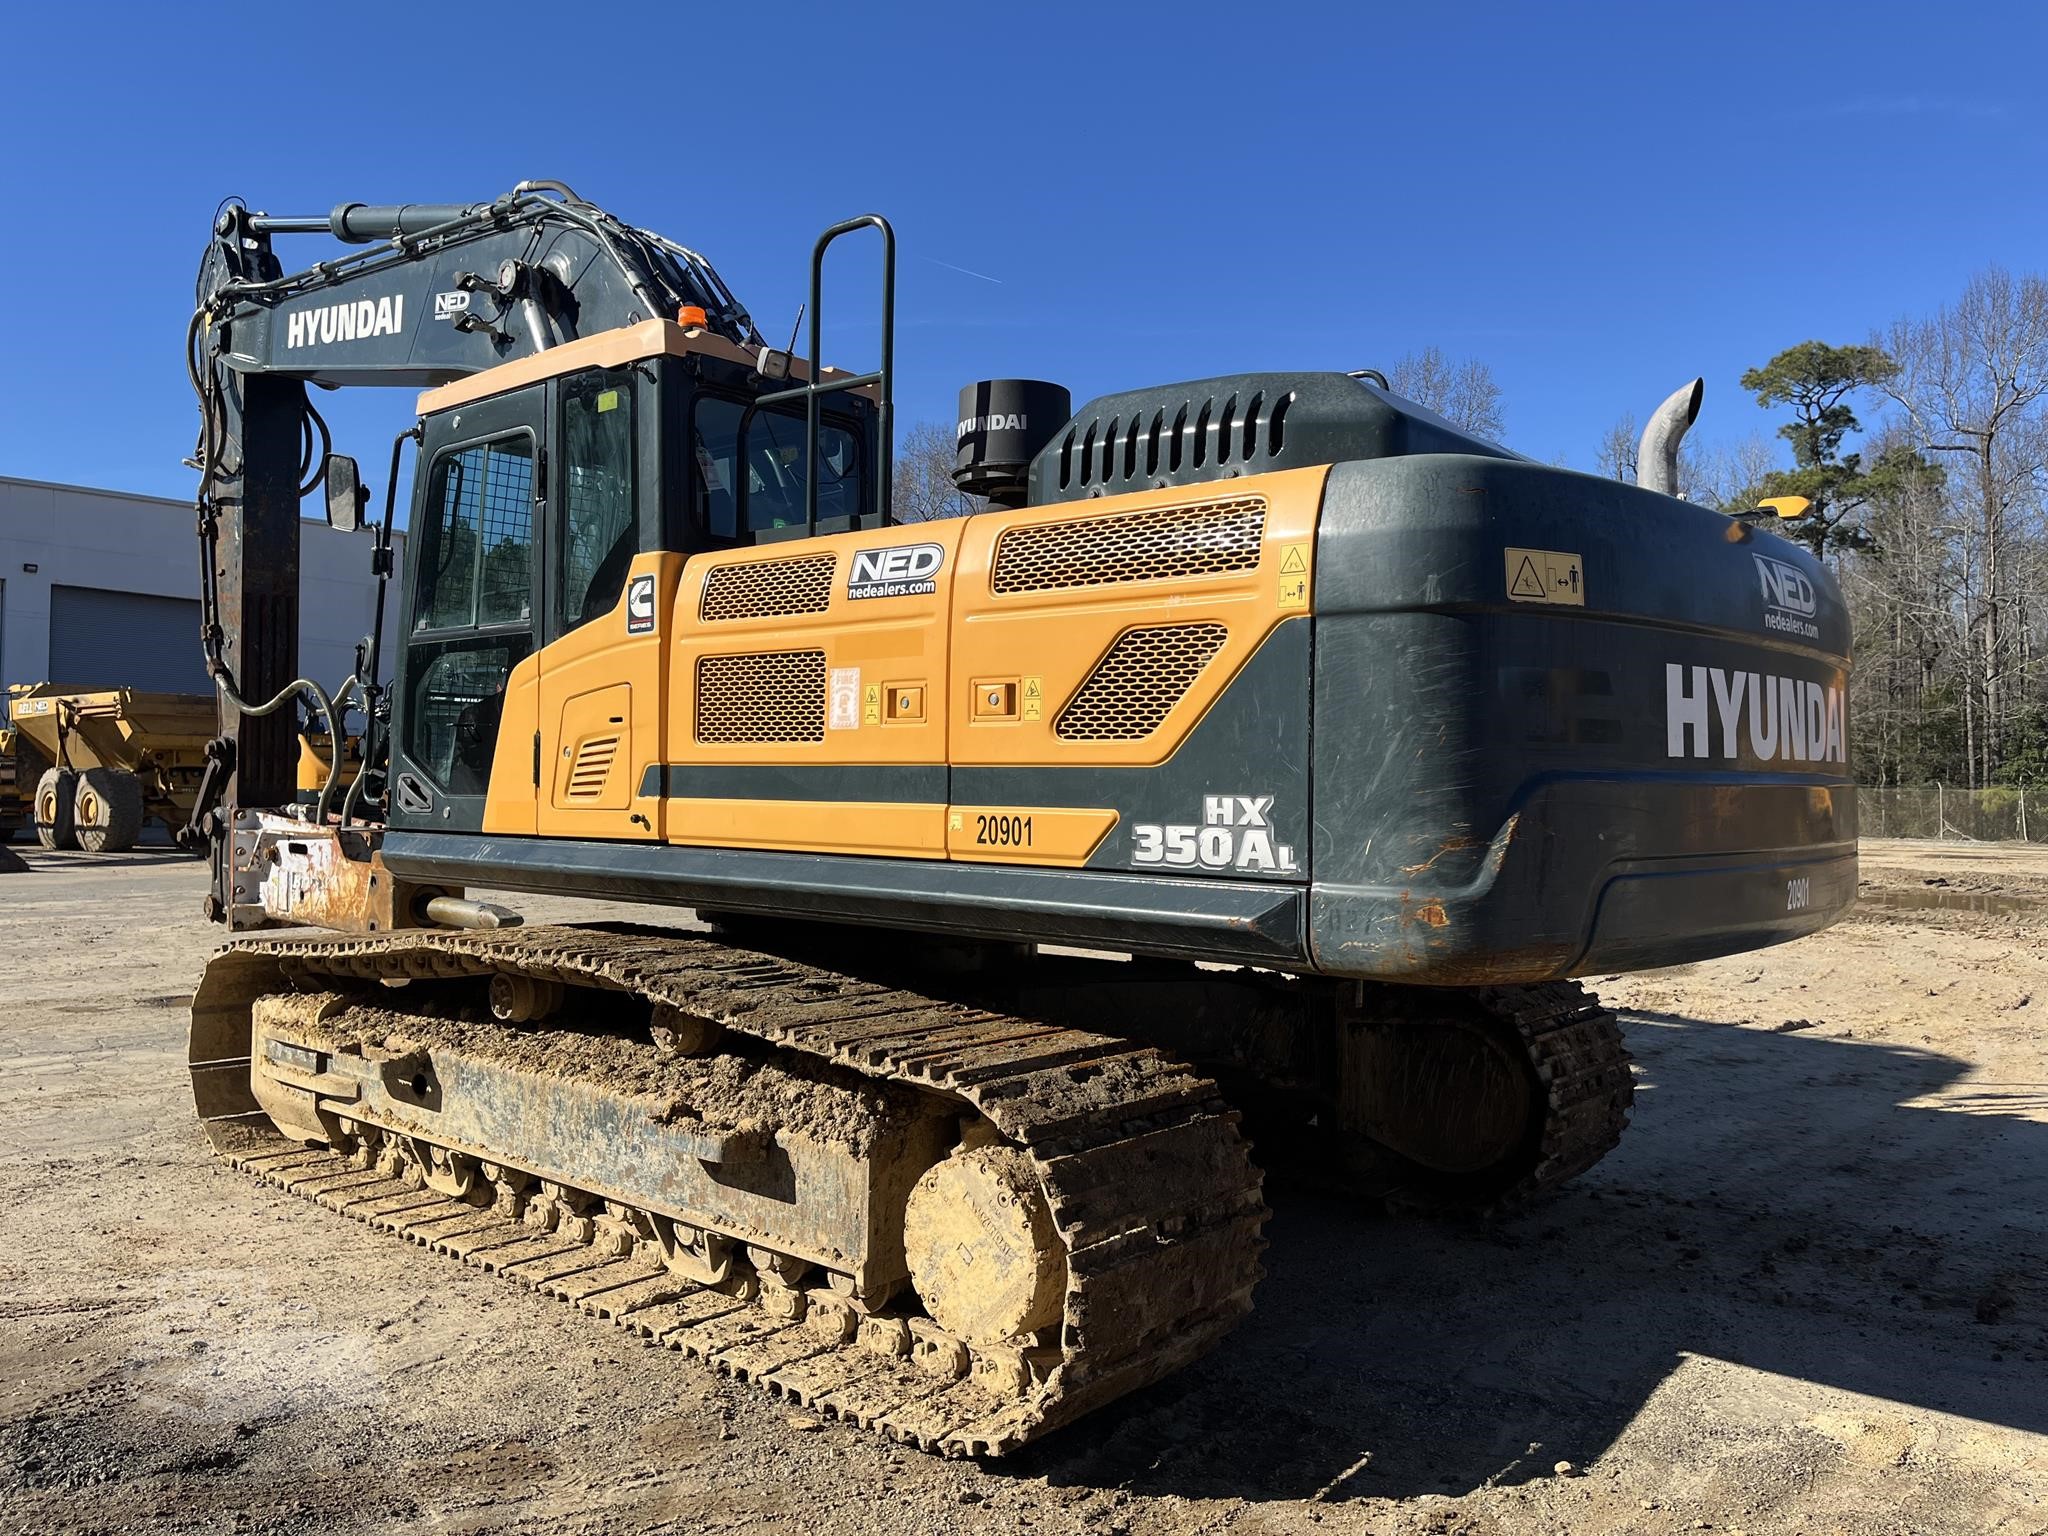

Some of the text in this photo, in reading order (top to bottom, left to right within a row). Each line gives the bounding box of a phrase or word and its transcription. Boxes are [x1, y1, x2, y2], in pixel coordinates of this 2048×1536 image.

[435, 291, 470, 312] NED
[287, 294, 404, 349] HYUNDAI
[850, 545, 942, 583] NED
[848, 581, 935, 599] nedealers.com
[1755, 556, 1816, 615] NED
[1764, 610, 1819, 640] nedealers.com
[1666, 663, 1846, 763] HYUNDAI
[1205, 796, 1270, 827] HX
[976, 814, 1032, 847] 20901
[1787, 876, 1809, 910] 20901
